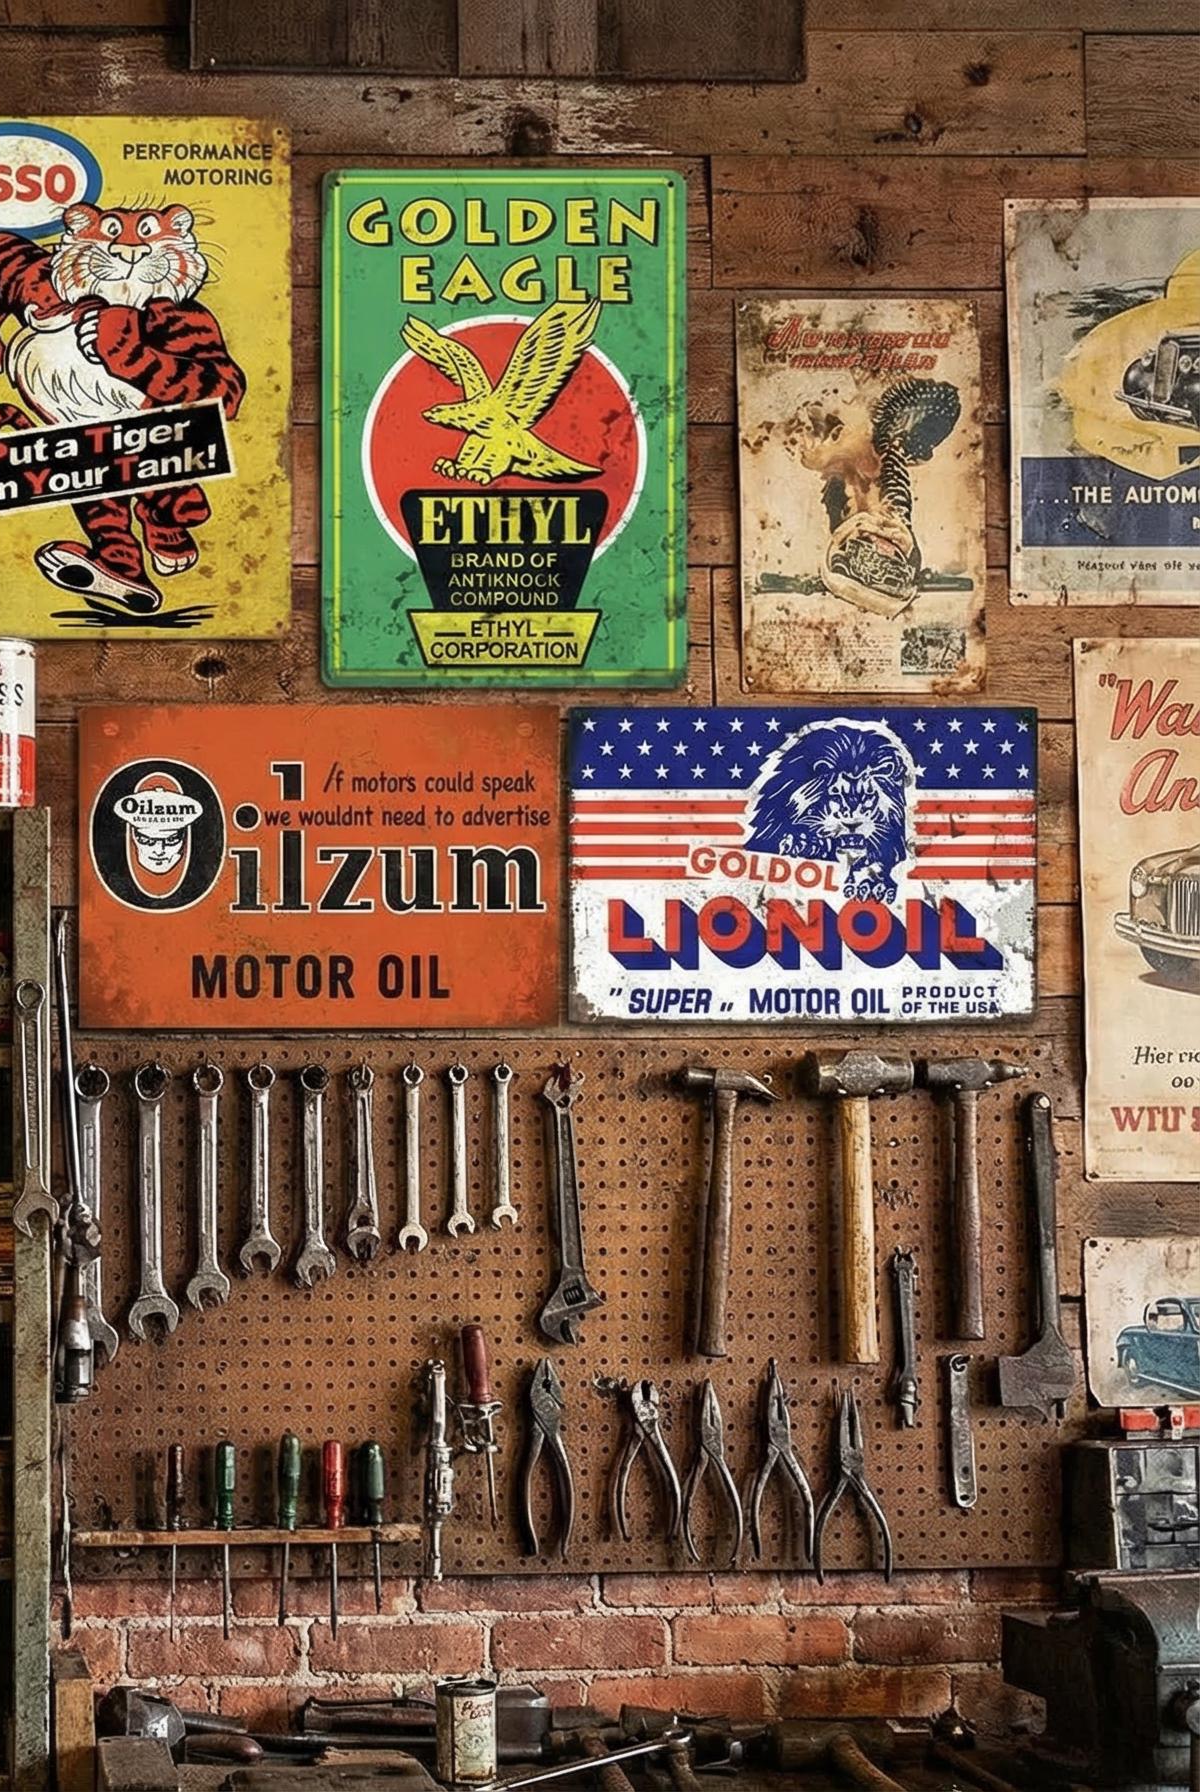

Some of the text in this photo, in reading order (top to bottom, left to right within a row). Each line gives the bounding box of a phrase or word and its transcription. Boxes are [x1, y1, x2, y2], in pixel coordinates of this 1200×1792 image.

[122, 143, 273, 161] PERFORMANCE
[163, 168, 273, 186] MOTORING
[347, 197, 660, 247] GOLDEN
[400, 253, 634, 304] EAGLE
[54, 438, 79, 460] a
[84, 420, 191, 455] Tiger
[24, 464, 110, 497] Your
[114, 443, 217, 482] Tank!
[1125, 486, 1200, 503] AUTOM
[418, 495, 591, 545] ETHYL
[450, 552, 558, 569] BRAND OF
[448, 572, 561, 588] ANTIKNOCK
[449, 590, 560, 607] COMPOUND
[470, 620, 539, 638] ETHYL
[430, 641, 580, 660] CORPORATION
[352, 771, 416, 792] motors
[425, 771, 474, 792] could
[481, 770, 536, 800] speak
[264, 804, 551, 827] we wouldnt need to advertise
[89, 757, 547, 914] Oilzum
[690, 844, 841, 893] GOLDOL
[191, 954, 451, 999] MOTOR OIL
[749, 988, 841, 1013] MOTOR
[851, 988, 891, 1013] OIL
[902, 986, 998, 998] PRODUCT
[902, 1001, 999, 1013] OF THE USA
